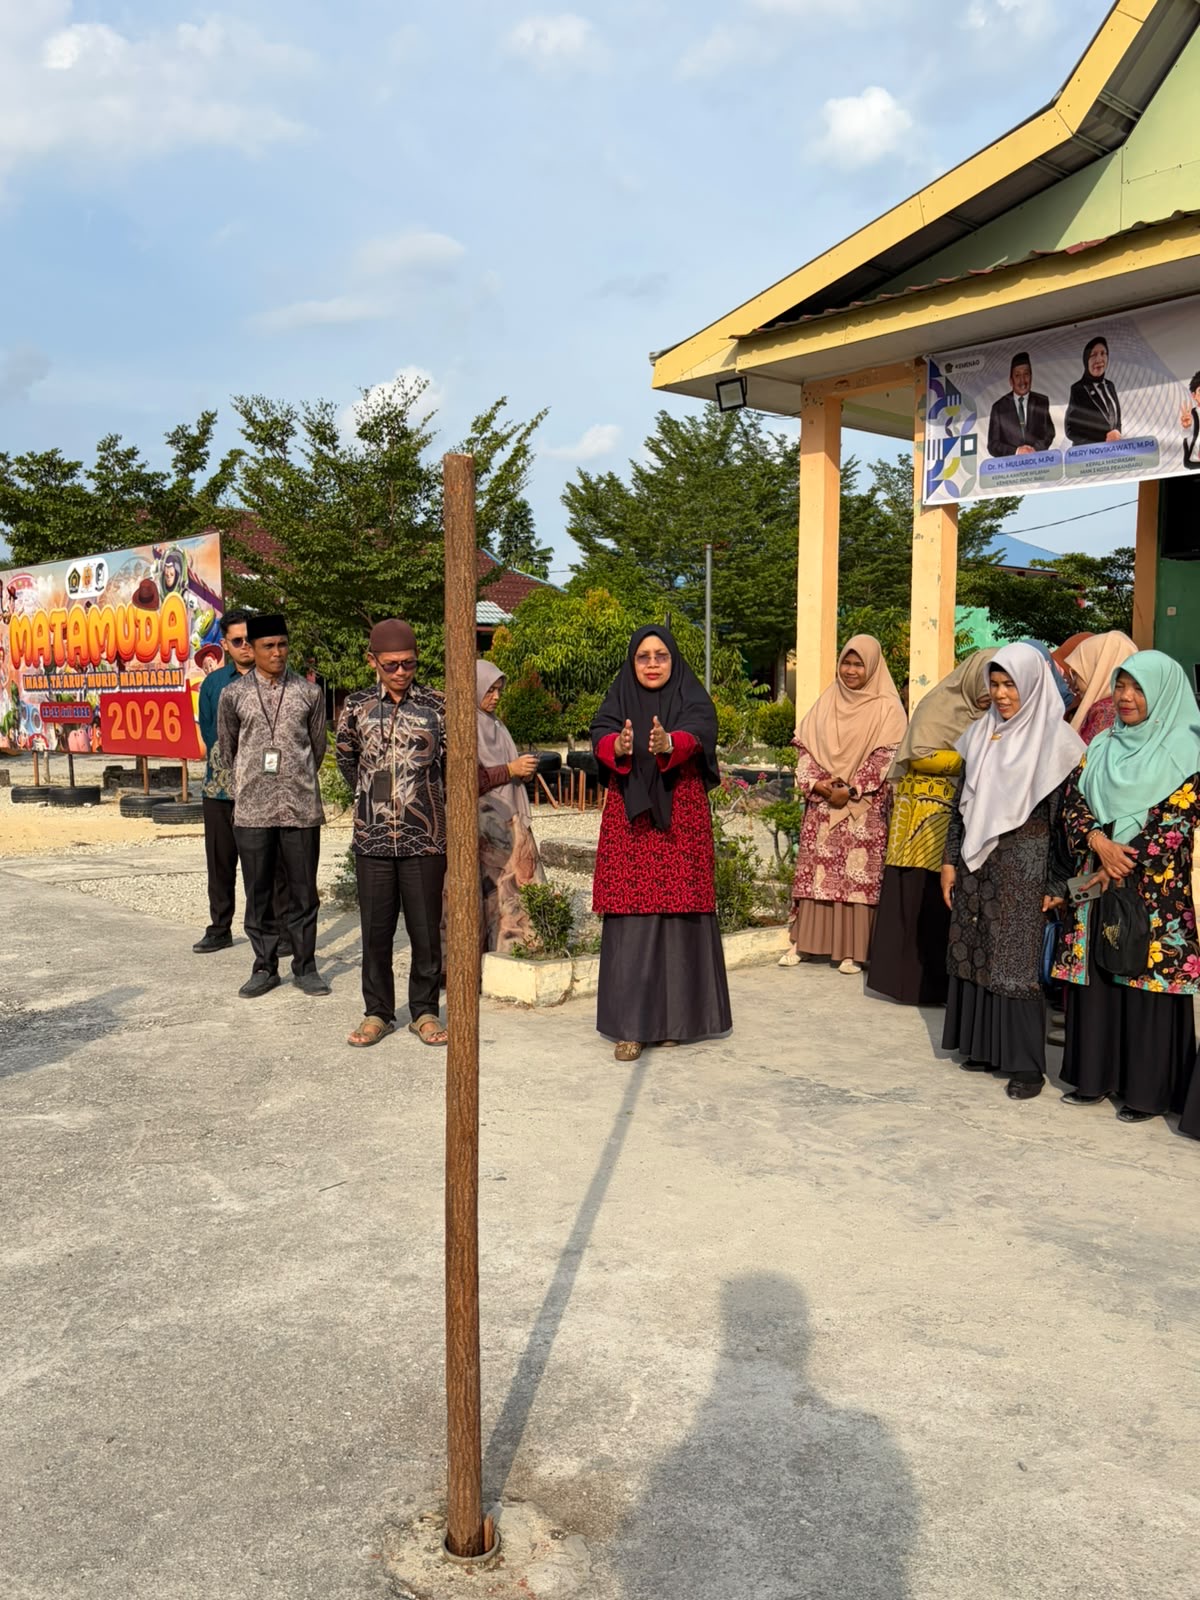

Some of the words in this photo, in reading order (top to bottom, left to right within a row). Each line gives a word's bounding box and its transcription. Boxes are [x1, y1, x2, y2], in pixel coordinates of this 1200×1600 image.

[1068, 449, 1088, 458] MERY
[9, 592, 190, 670] MATAMUDA
[87, 673, 118, 689] MURID
[108, 701, 182, 742] 2026
